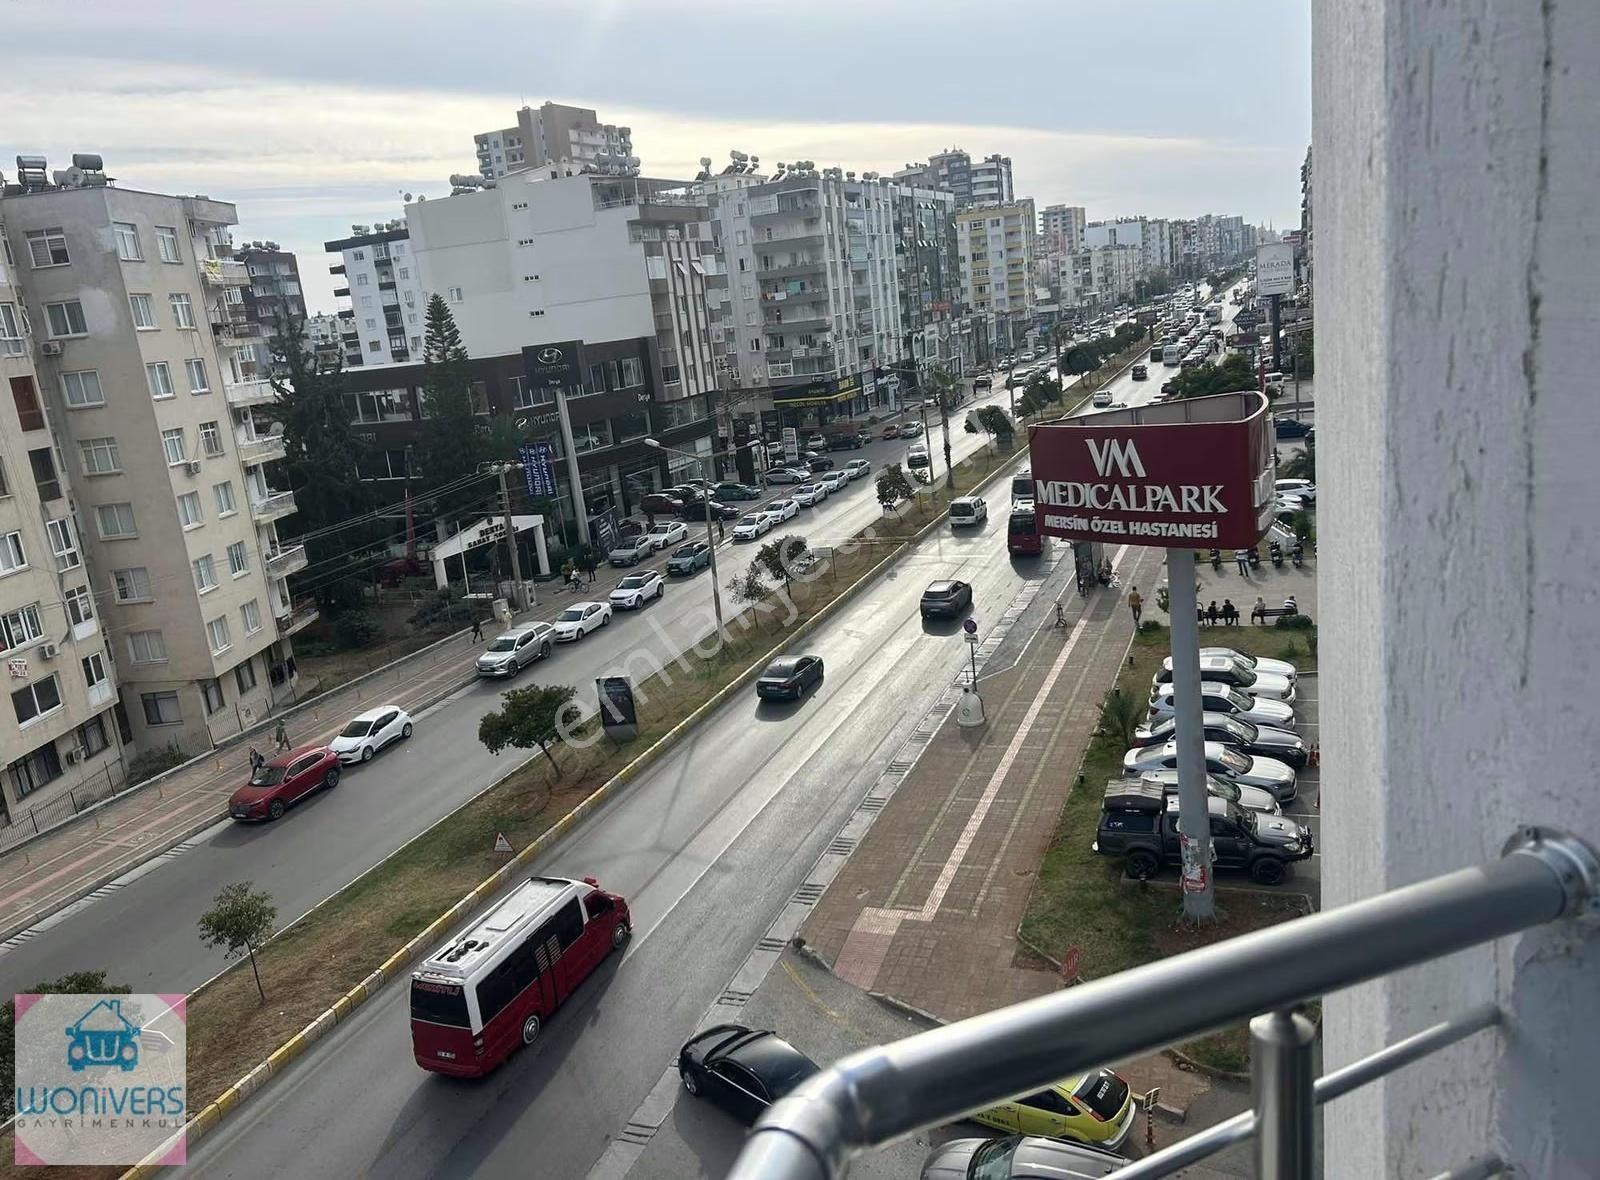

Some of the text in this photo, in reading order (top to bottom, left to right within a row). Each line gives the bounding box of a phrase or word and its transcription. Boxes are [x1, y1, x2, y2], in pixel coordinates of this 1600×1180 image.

[1085, 438, 1147, 478] VM
[1044, 514, 1218, 539] MERSİN ÖZEL HASTANESİ
